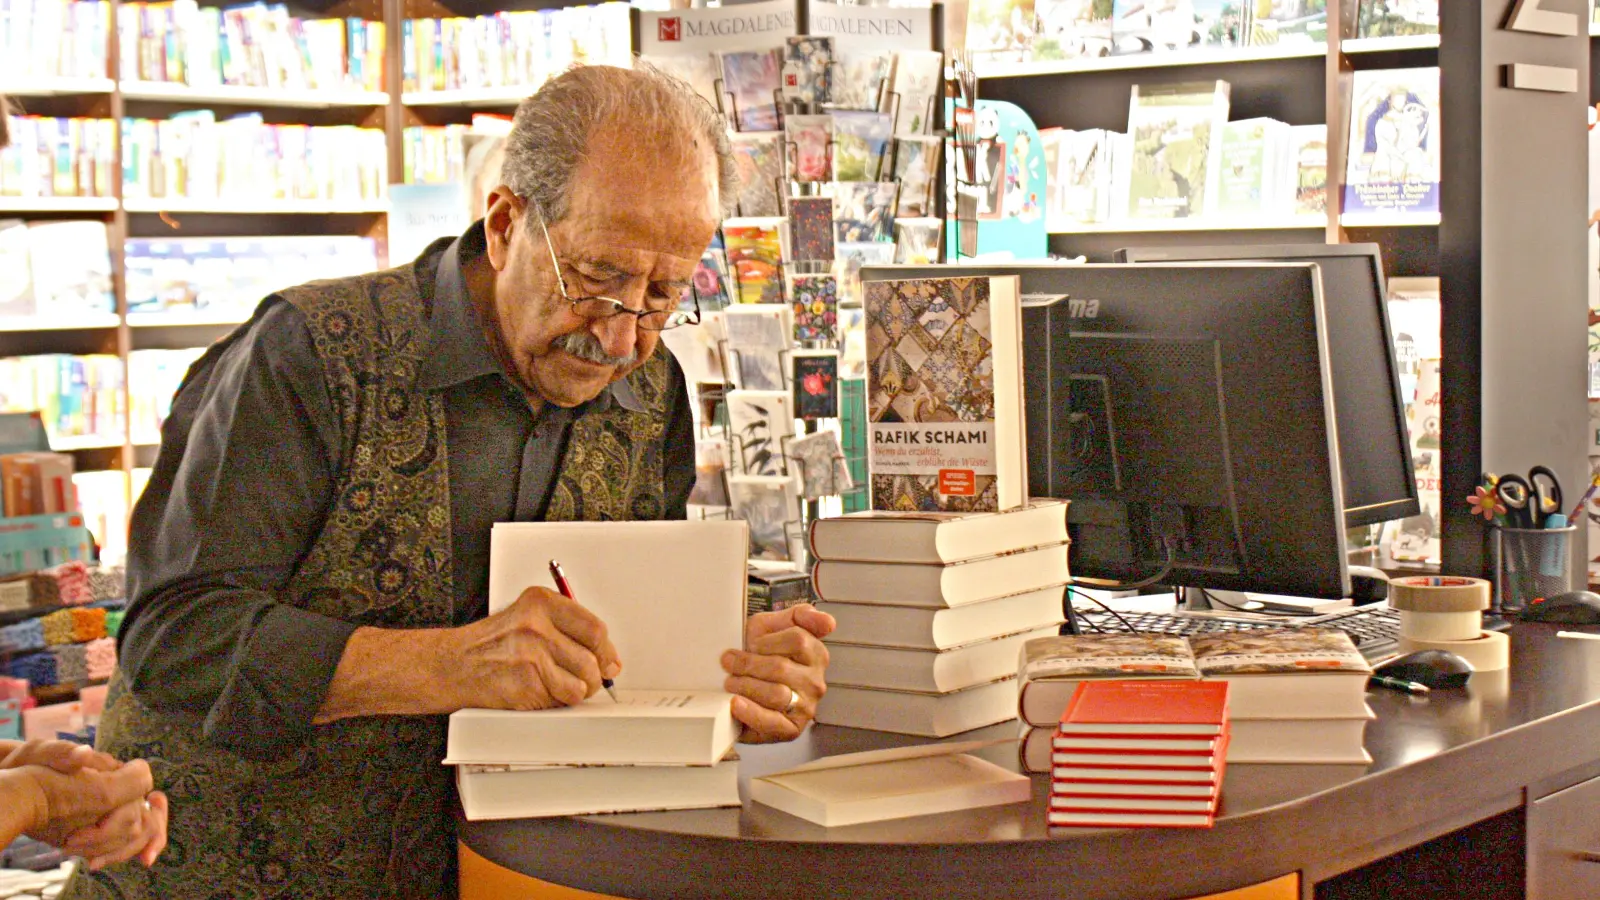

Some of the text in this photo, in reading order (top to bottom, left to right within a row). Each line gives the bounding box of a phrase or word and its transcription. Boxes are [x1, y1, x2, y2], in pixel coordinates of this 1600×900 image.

[875, 431, 988, 444] RAFIK SCHAMI
[897, 446, 907, 456] du
[947, 457, 960, 467] die
[962, 456, 989, 467] Wüste
